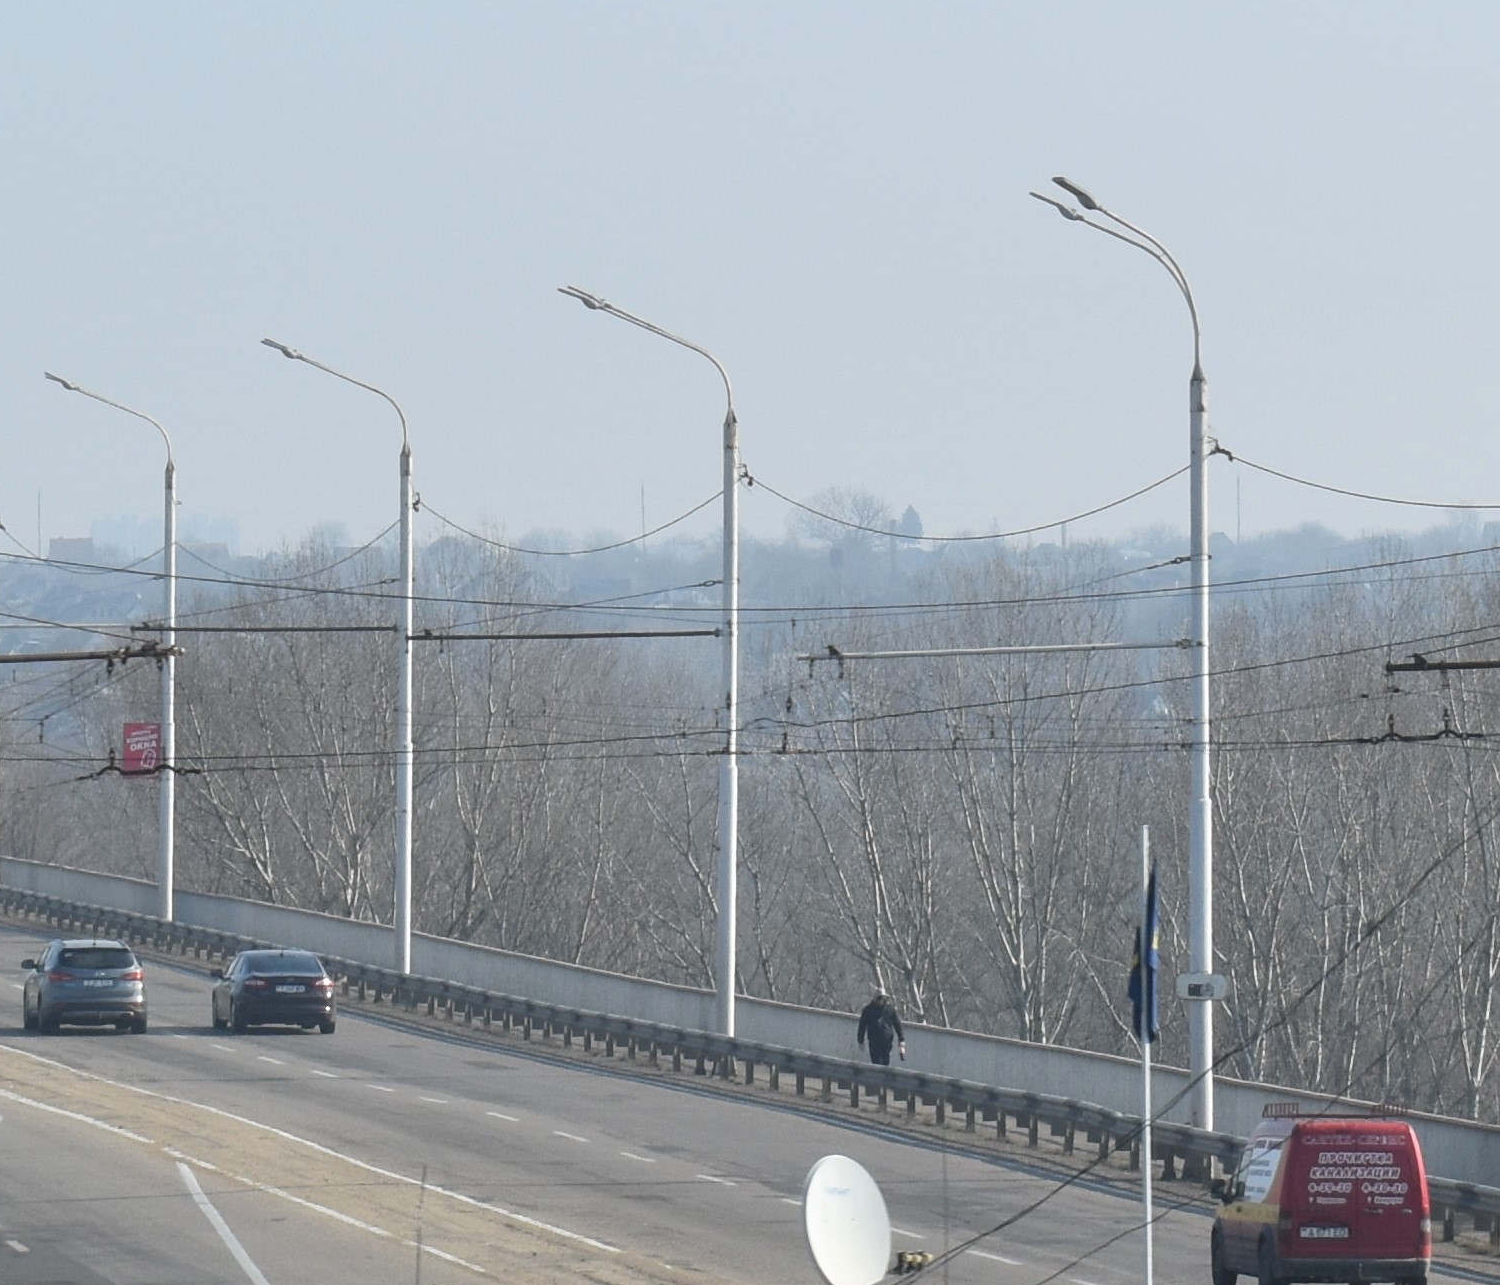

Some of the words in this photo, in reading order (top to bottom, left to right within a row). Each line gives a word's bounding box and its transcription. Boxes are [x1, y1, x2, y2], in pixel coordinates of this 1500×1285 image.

[130, 740, 157, 752] ОКНА
[1318, 1152, 1394, 1164] ПРОЧИСТКА
[1309, 1167, 1401, 1180] КАНАЛИЗАЦИИ
